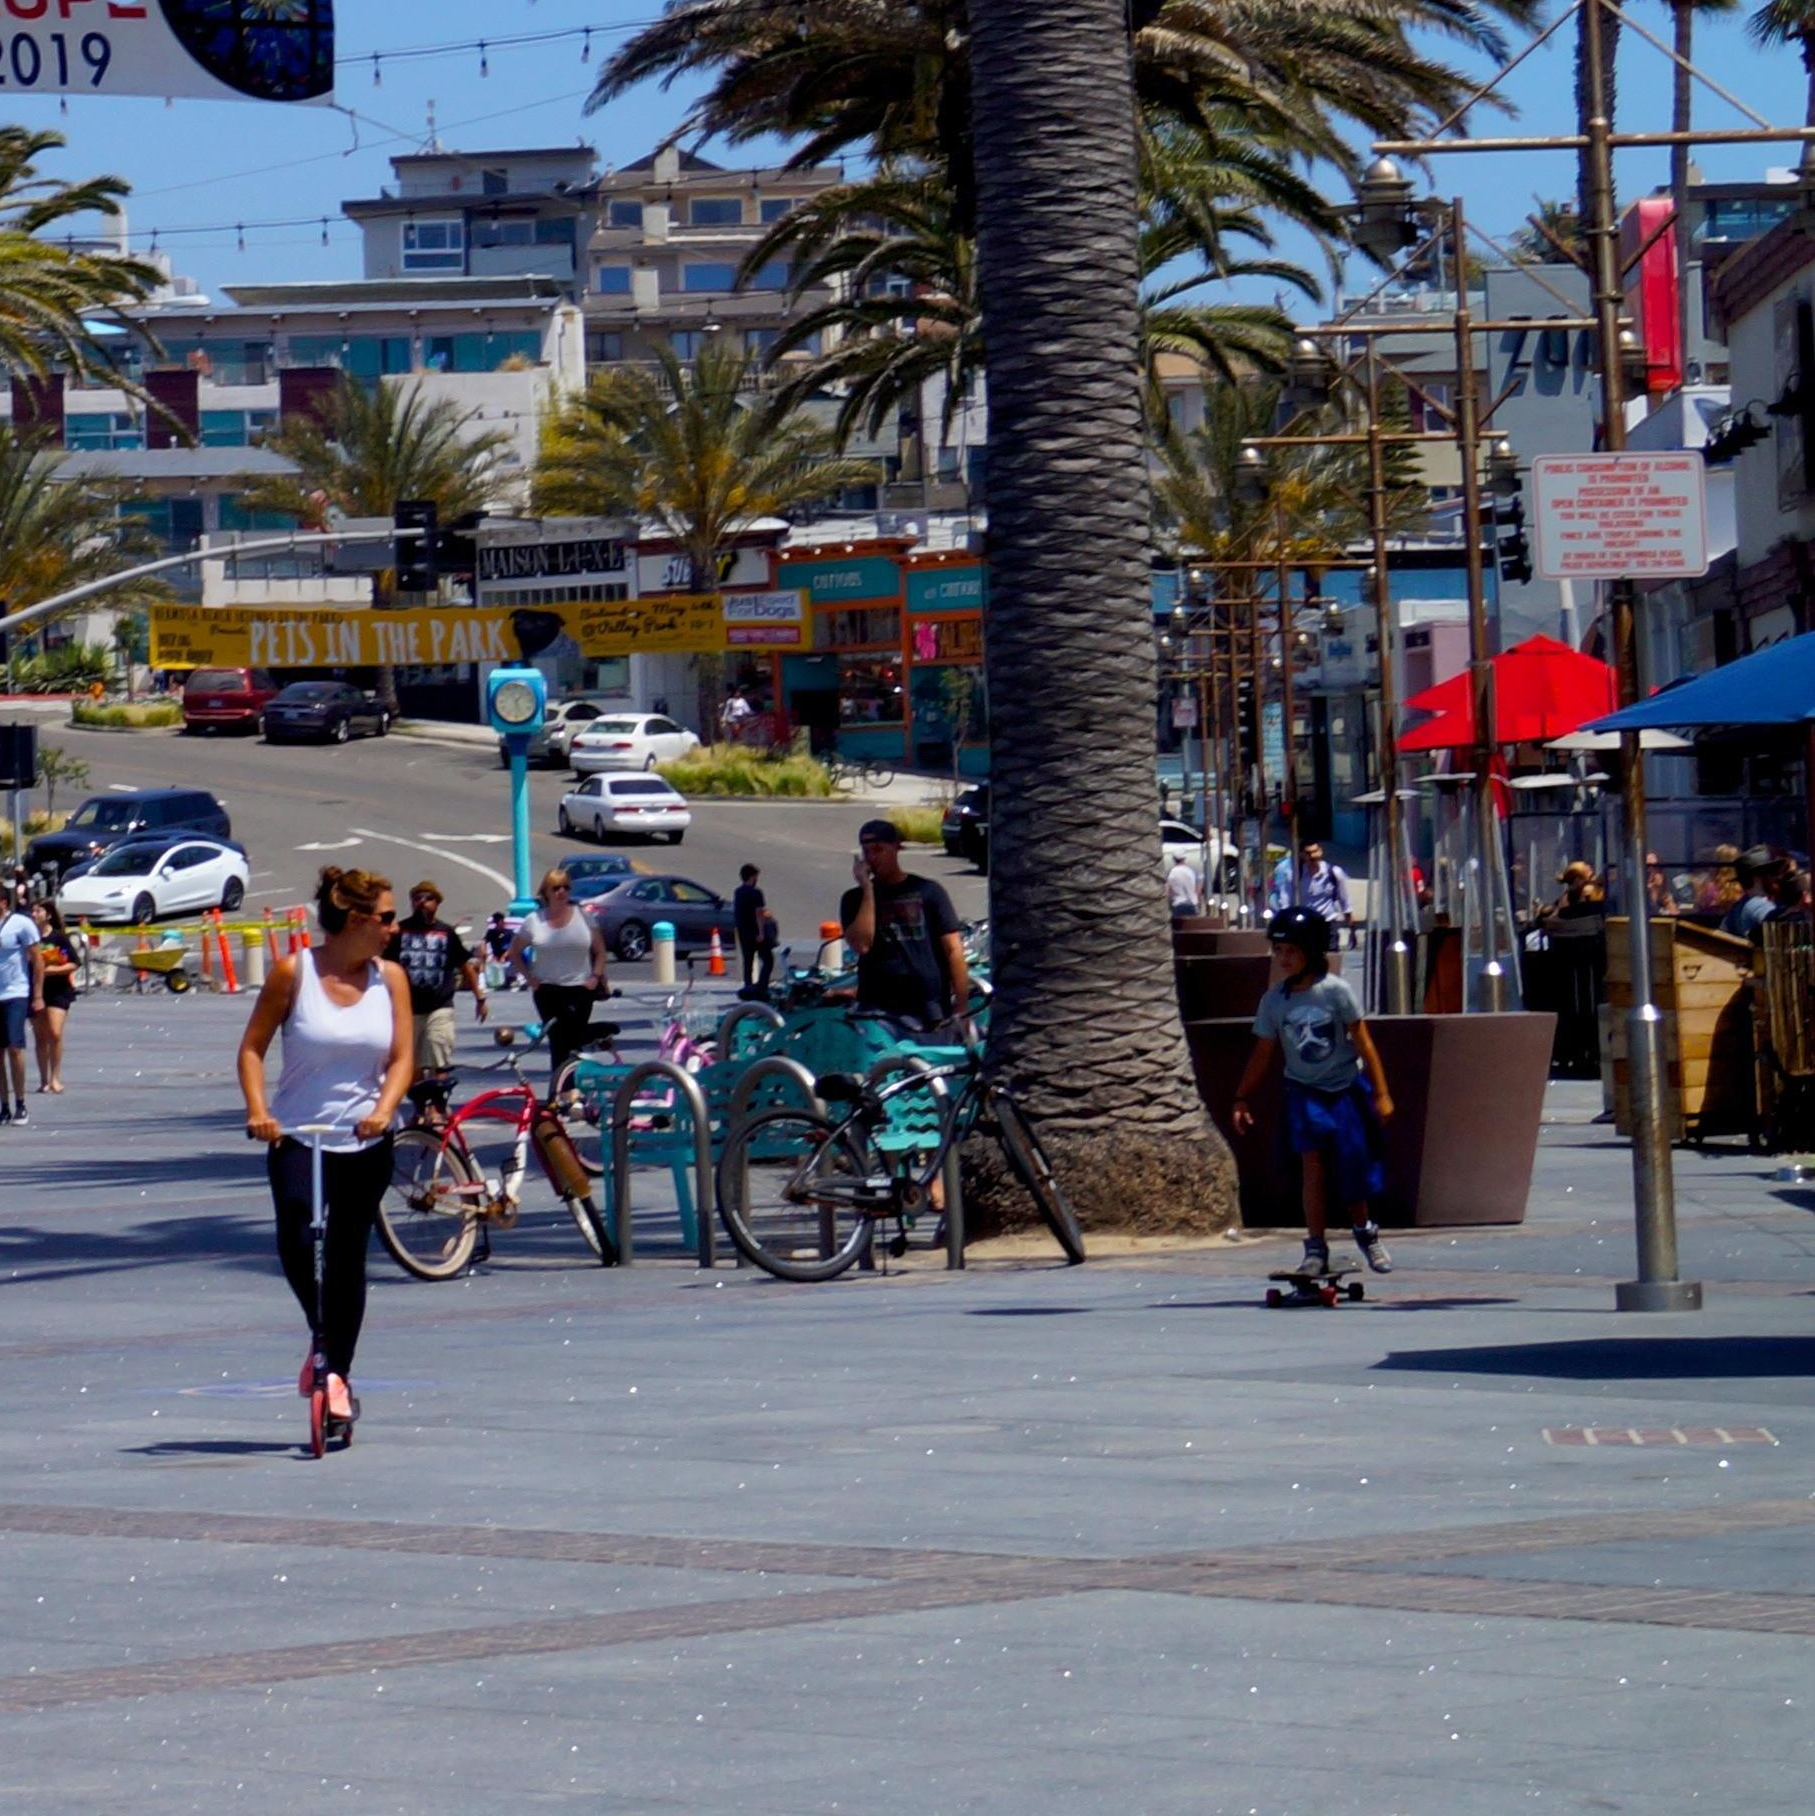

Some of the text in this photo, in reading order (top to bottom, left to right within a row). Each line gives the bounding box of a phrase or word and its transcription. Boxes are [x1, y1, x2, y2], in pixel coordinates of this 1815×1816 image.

[481, 545, 549, 577] MAISON
[249, 618, 509, 665] PETS IN THE PARK
